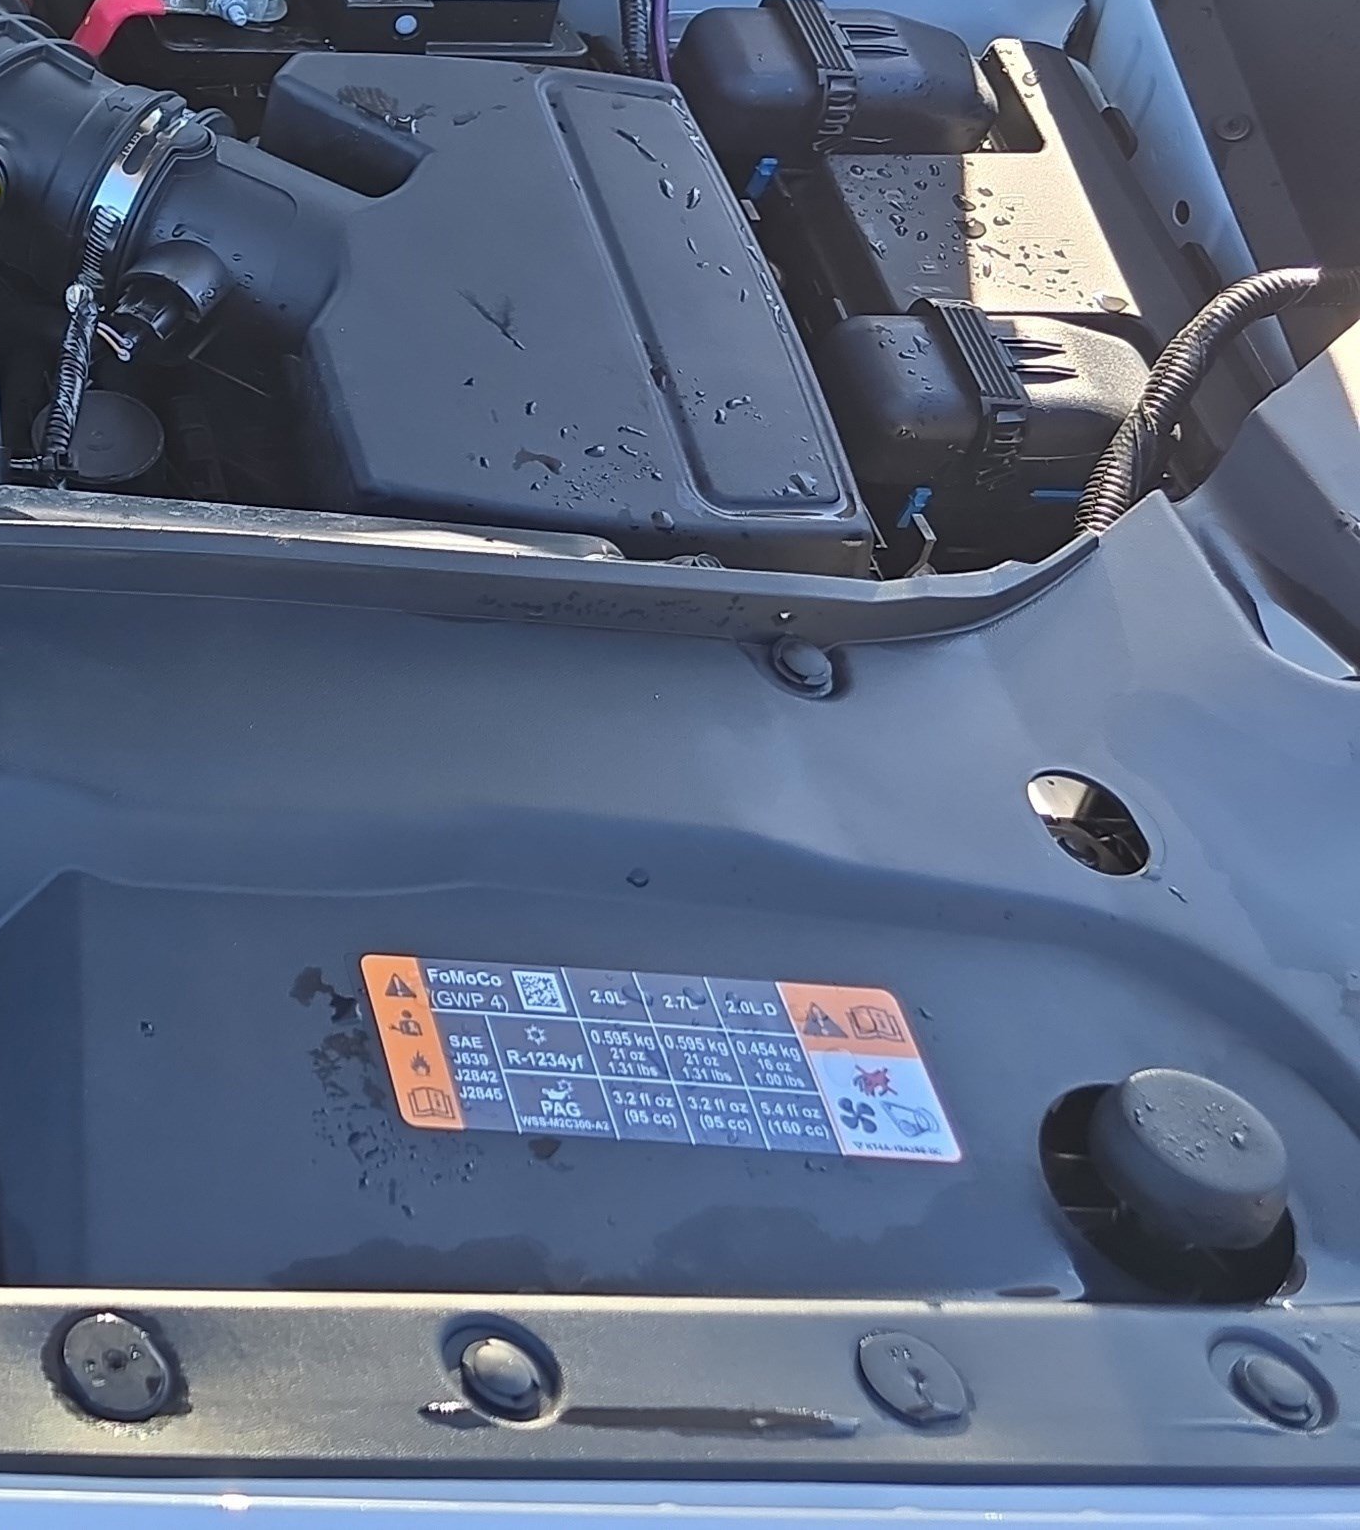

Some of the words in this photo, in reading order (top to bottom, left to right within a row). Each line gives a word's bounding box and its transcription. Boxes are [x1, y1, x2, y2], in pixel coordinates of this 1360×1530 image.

[426, 968, 502, 987] FoMoCo
[430, 989, 484, 1009] (GWP
[490, 994, 509, 1013] 4)
[590, 989, 627, 1006] 2.0L
[662, 994, 699, 1011] 2.7L
[726, 1000, 762, 1015] 2.0L
[763, 1002, 777, 1017] D
[448, 1035, 484, 1049] SAE
[590, 1029, 631, 1046] 0.595
[633, 1032, 655, 1050] kg
[664, 1034, 705, 1052] 0.595
[707, 1037, 729, 1056] kg
[610, 1047, 627, 1059] 21
[629, 1051, 646, 1062] oz
[683, 1052, 700, 1065] 21
[703, 1056, 720, 1067] oz
[737, 1041, 777, 1057] 0.454
[779, 1043, 801, 1062] kg
[506, 1049, 584, 1072] R-1234yf
[757, 1058, 774, 1070] 16
[776, 1062, 793, 1072] oz
[607, 1062, 634, 1075] 1.31
[636, 1064, 658, 1077] lbs
[682, 1067, 708, 1080] 1.31
[710, 1069, 732, 1082] lbs
[755, 1072, 782, 1085] 1.00
[783, 1075, 805, 1088] lbs
[612, 1090, 637, 1106] 3.2
[639, 1092, 650, 1106] fl
[654, 1096, 675, 1108] oz
[687, 1096, 712, 1111] 3.2
[714, 1098, 725, 1112] fl
[729, 1102, 749, 1114] oz
[540, 1100, 582, 1117] PAG
[760, 1102, 783, 1117] 5.4
[786, 1103, 798, 1118] fl
[801, 1107, 823, 1119] oz
[624, 1108, 650, 1127] (95
[652, 1111, 678, 1129] cc)
[699, 1114, 725, 1131] (95
[727, 1118, 753, 1135] cc)
[767, 1119, 801, 1137] (160
[803, 1124, 830, 1141] cc)
